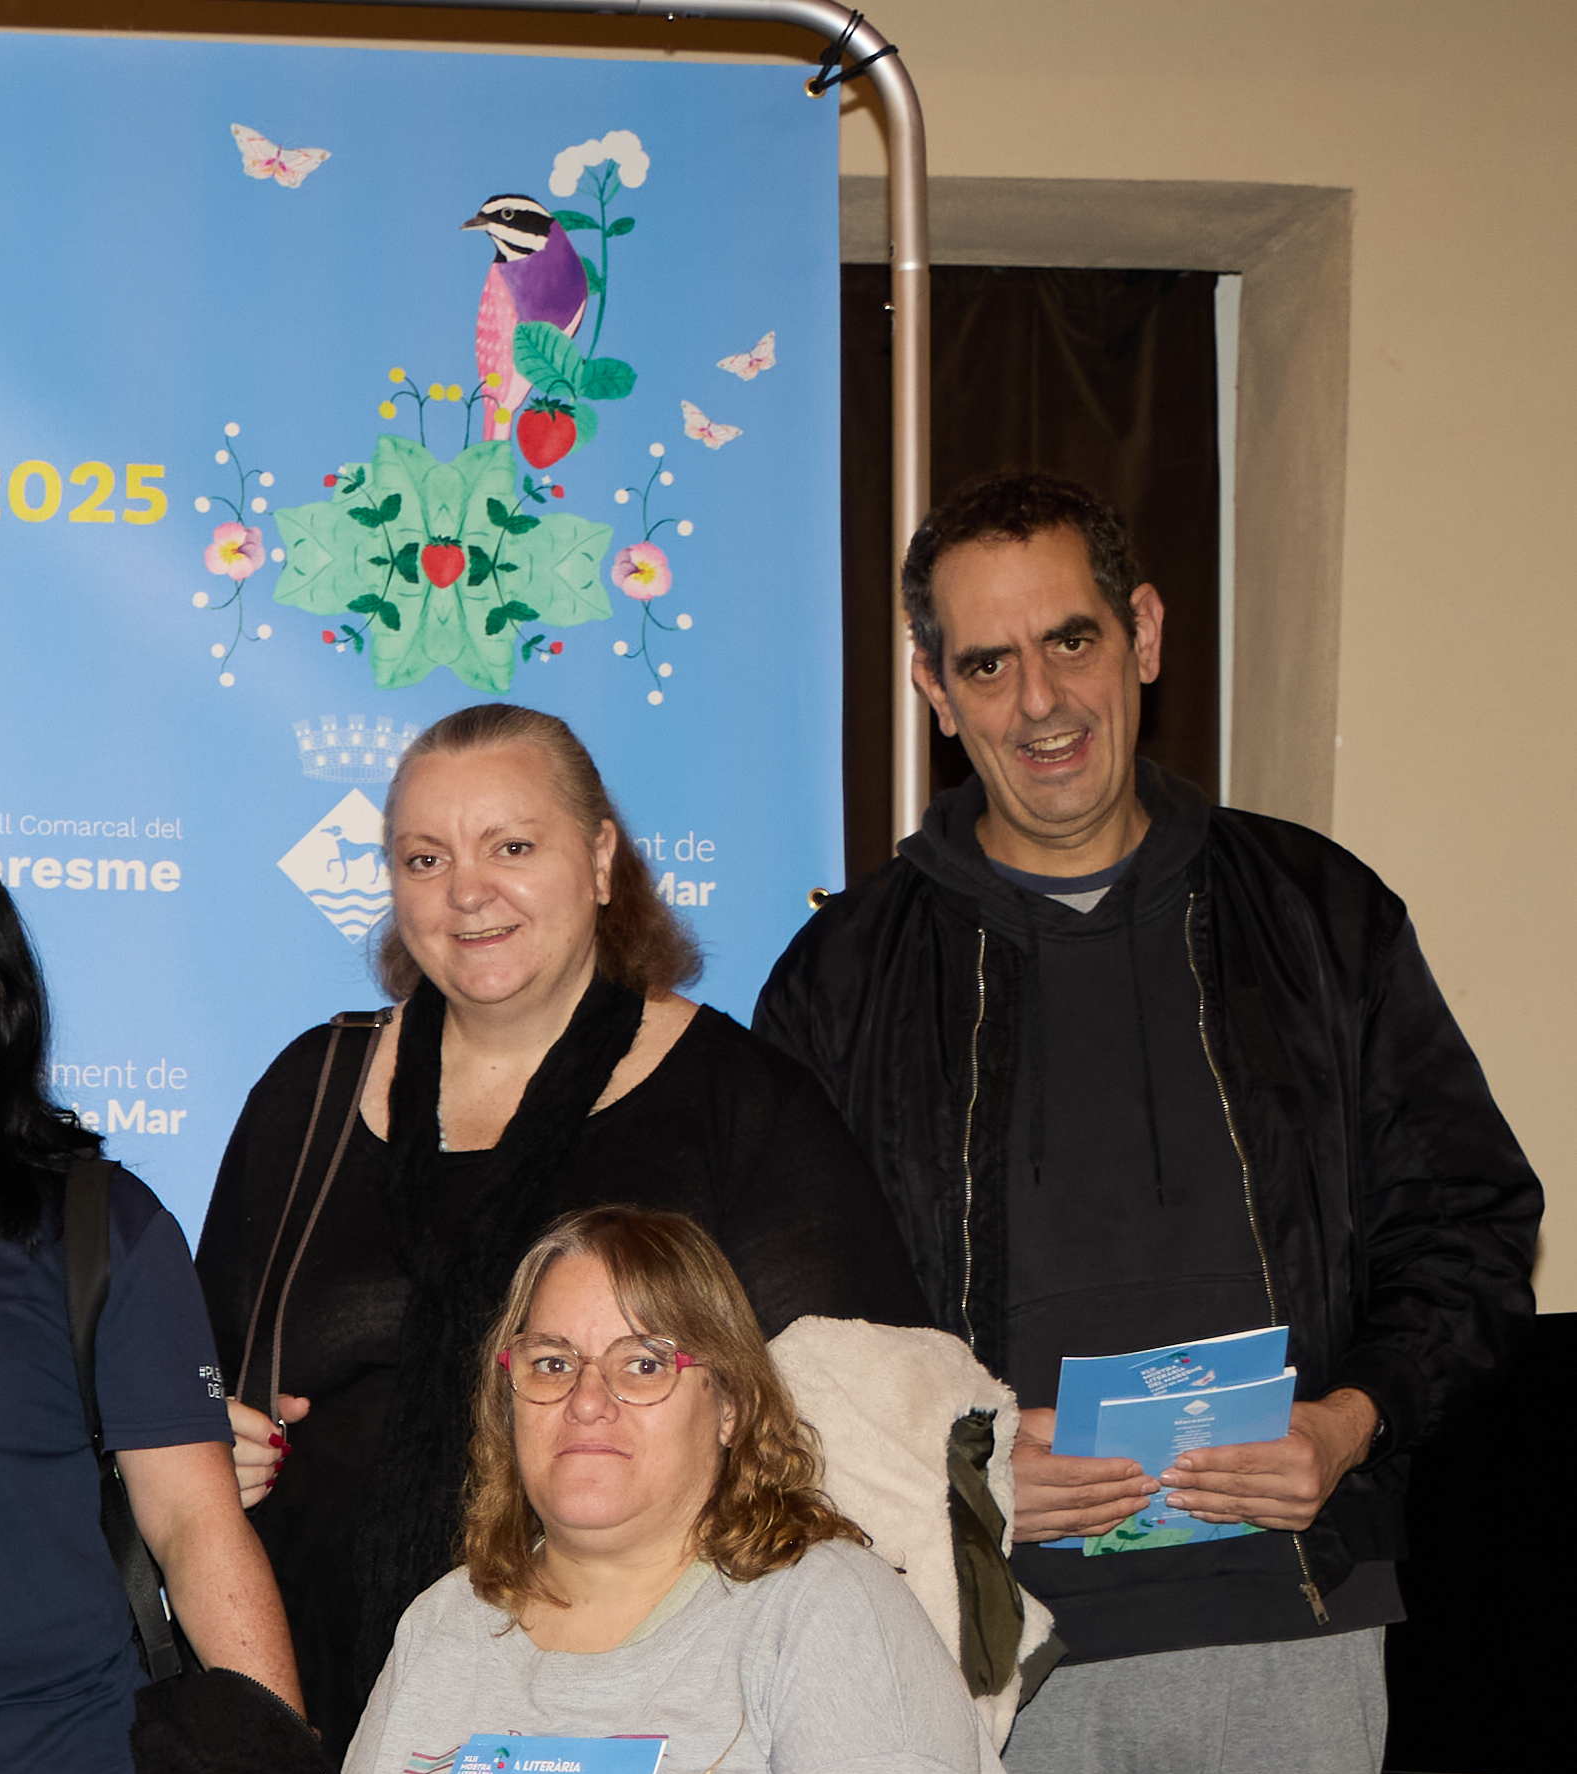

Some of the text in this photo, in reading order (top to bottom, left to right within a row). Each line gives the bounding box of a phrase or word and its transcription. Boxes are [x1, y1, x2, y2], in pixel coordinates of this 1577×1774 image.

[19, 814, 139, 839] Comarcal
[145, 817, 183, 840] del
[675, 830, 716, 862] de
[146, 1057, 187, 1090] de
[107, 1099, 188, 1135] Mar
[459, 1763, 492, 1771] MOSTRA
[522, 1757, 581, 1773] LITERÀRIA
